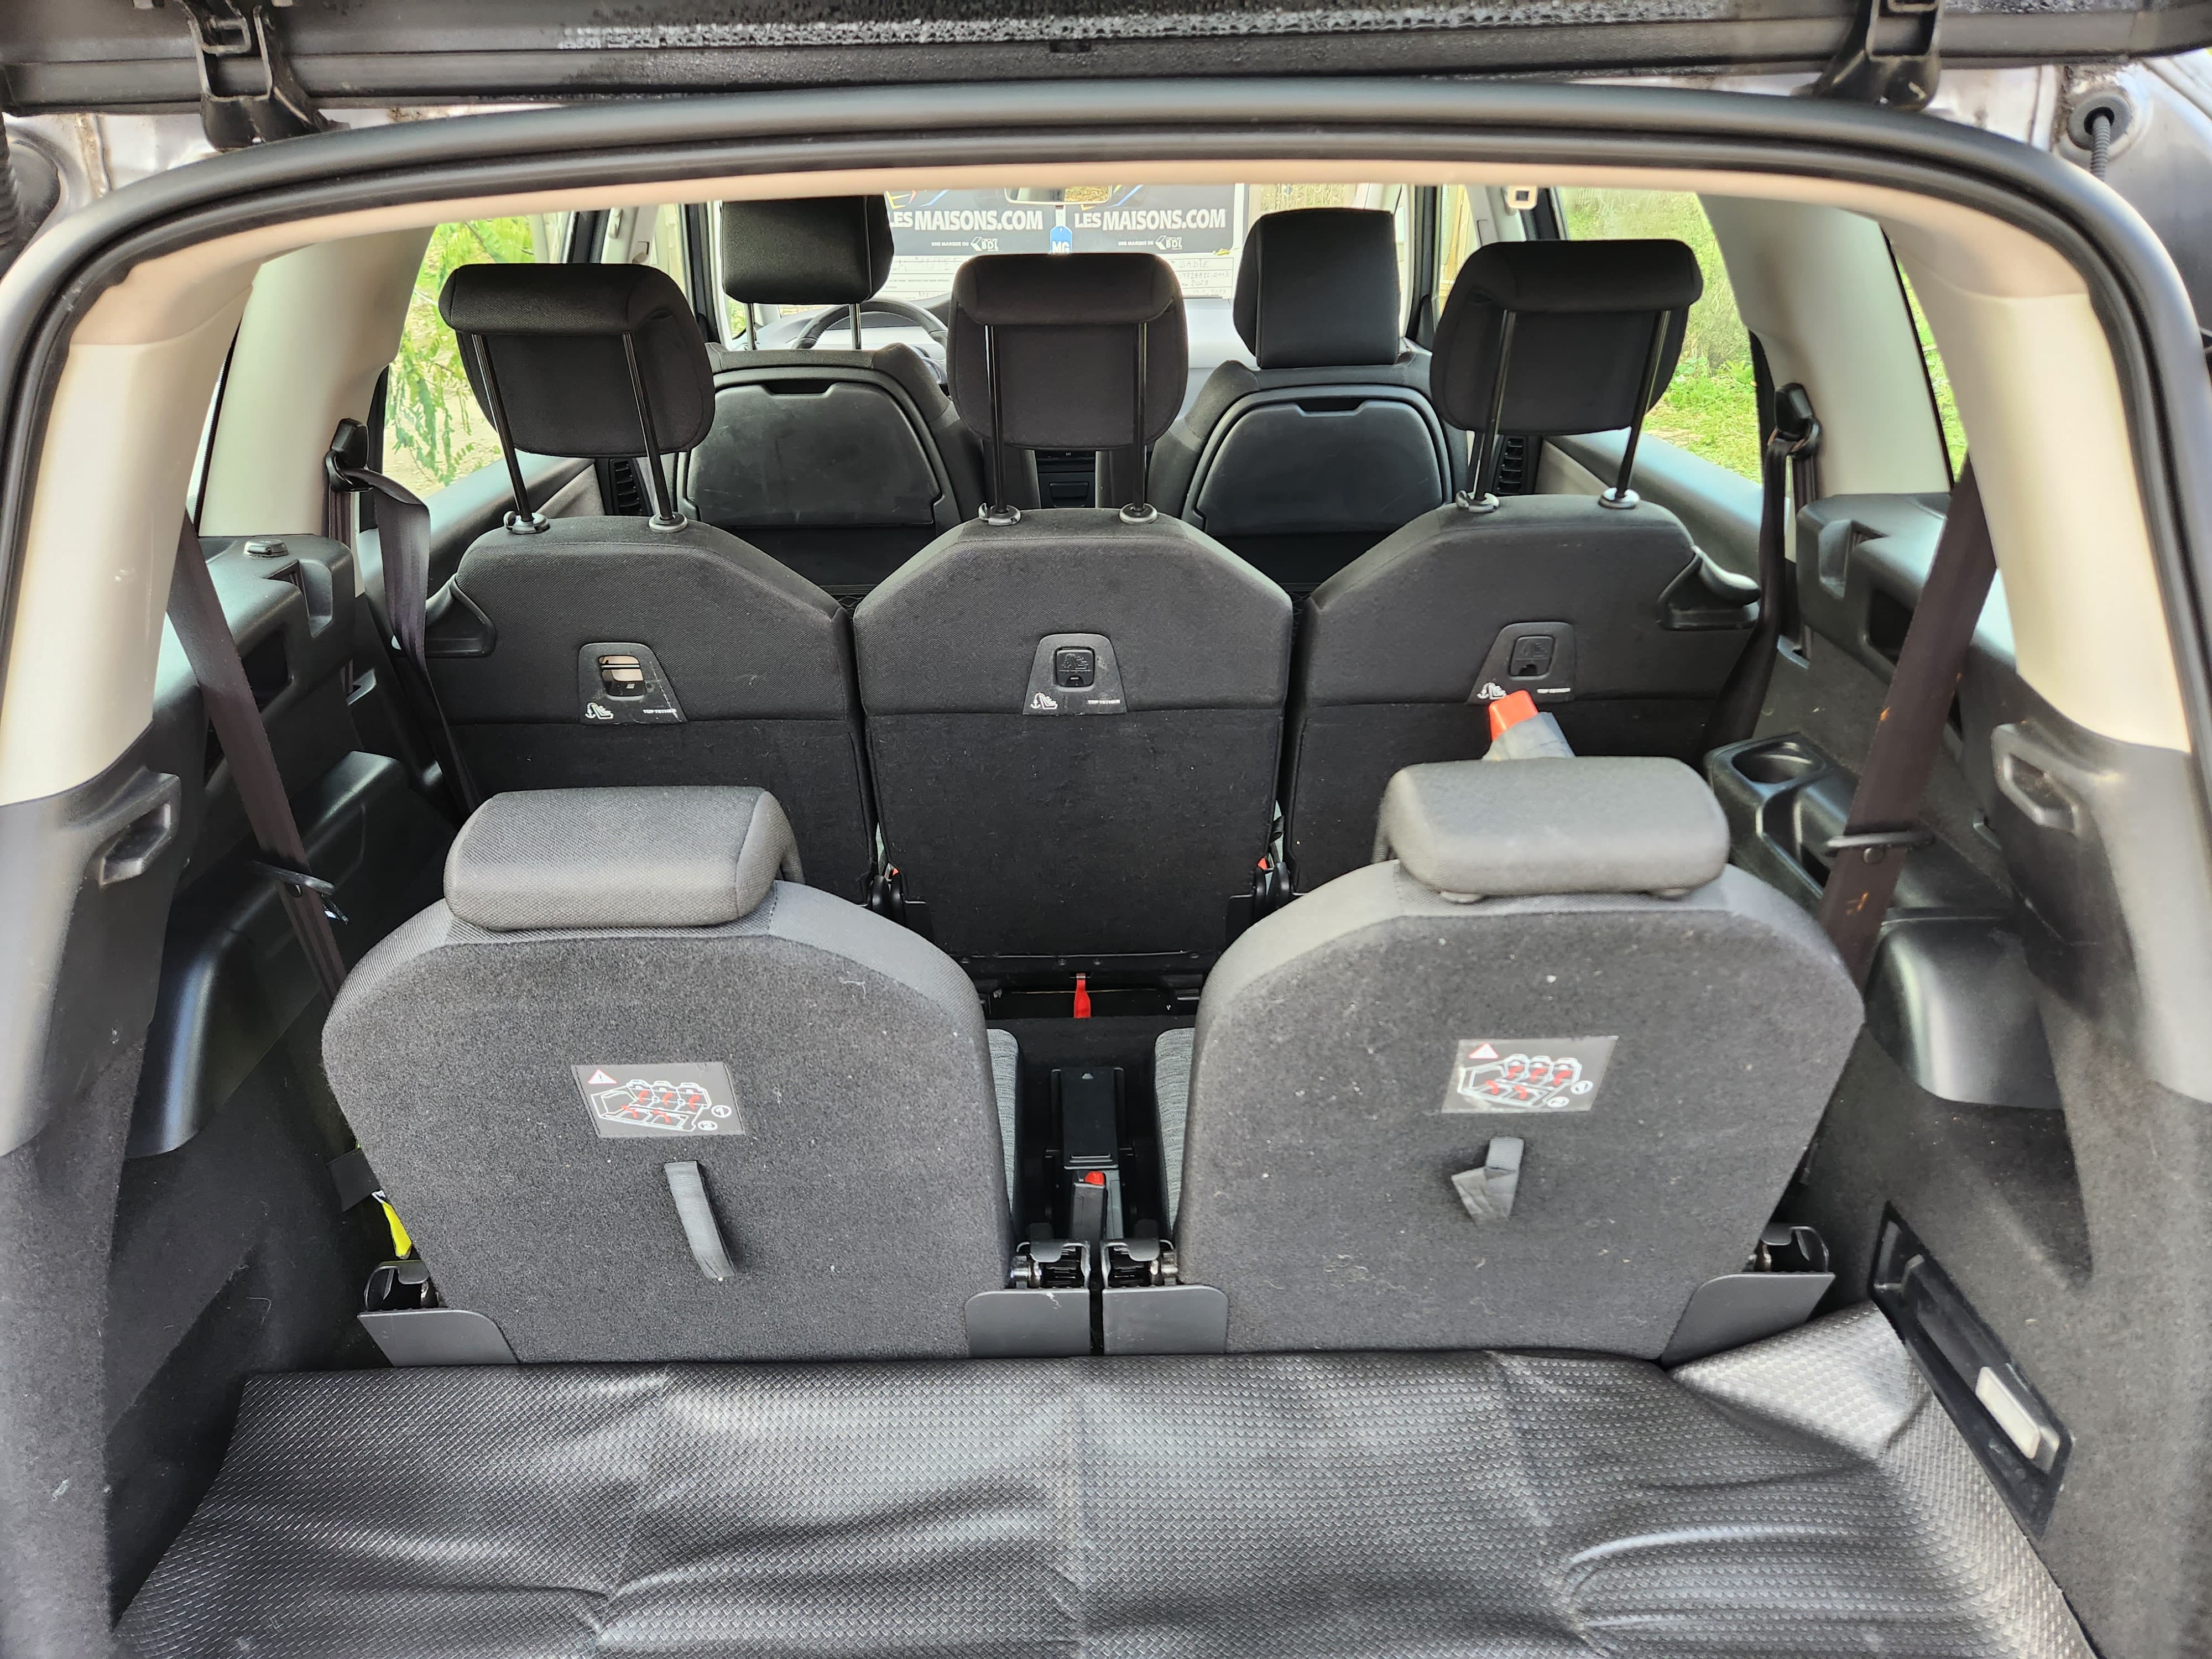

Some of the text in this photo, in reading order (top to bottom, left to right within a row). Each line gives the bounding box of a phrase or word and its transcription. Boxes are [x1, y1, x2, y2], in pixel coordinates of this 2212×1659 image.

[915, 210, 1044, 231] MAISONS.COM
[1074, 208, 1226, 231] LES MAISONS.COM
[982, 241, 999, 249] BDL
[1166, 239, 1182, 248] BDL
